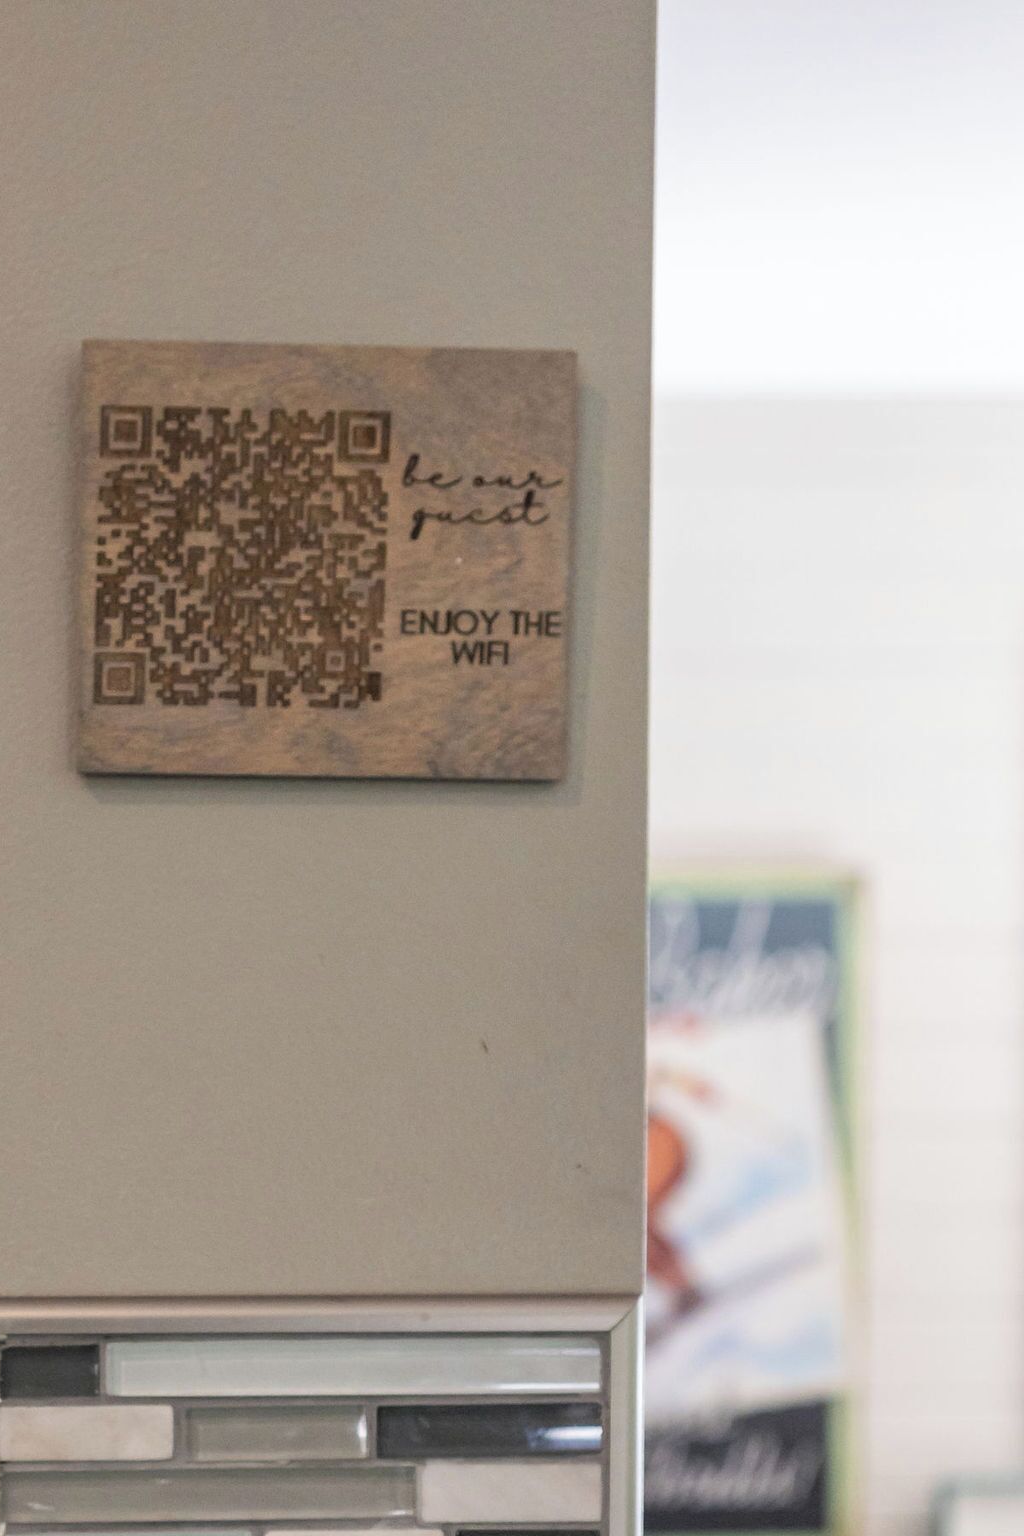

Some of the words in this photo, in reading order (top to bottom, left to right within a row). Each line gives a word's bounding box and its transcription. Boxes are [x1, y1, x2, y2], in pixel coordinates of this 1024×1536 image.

[402, 453, 463, 489] be
[472, 470, 564, 490] our
[409, 490, 551, 540] guest
[400, 609, 501, 635] ENJOY
[509, 610, 562, 637] THE
[451, 640, 510, 666] WIFI
